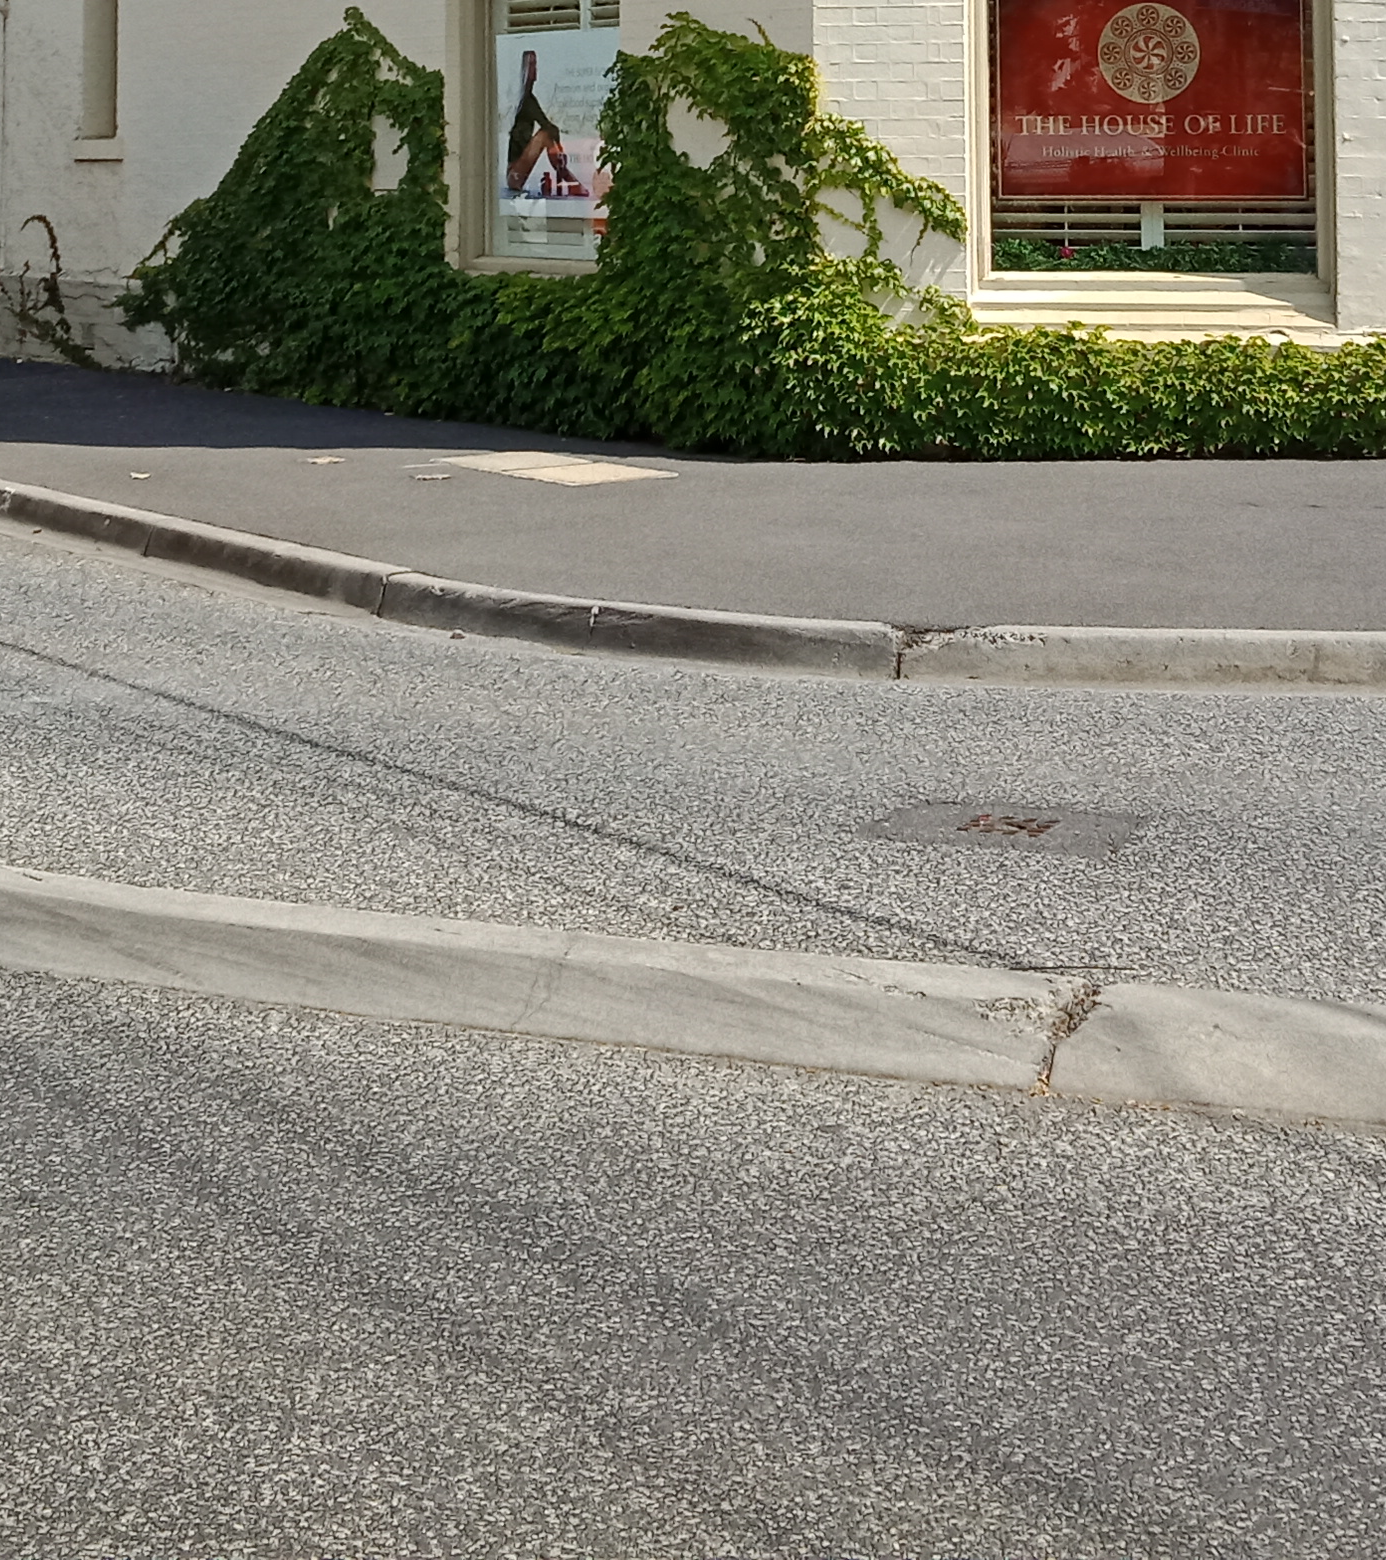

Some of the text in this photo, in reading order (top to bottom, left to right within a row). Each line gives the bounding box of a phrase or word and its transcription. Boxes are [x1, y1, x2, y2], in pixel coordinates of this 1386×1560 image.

[1015, 114, 1287, 135] THE HOUSE OF LIFE
[1042, 144, 1260, 159] Holistic Health & Wellbeing Clinic
